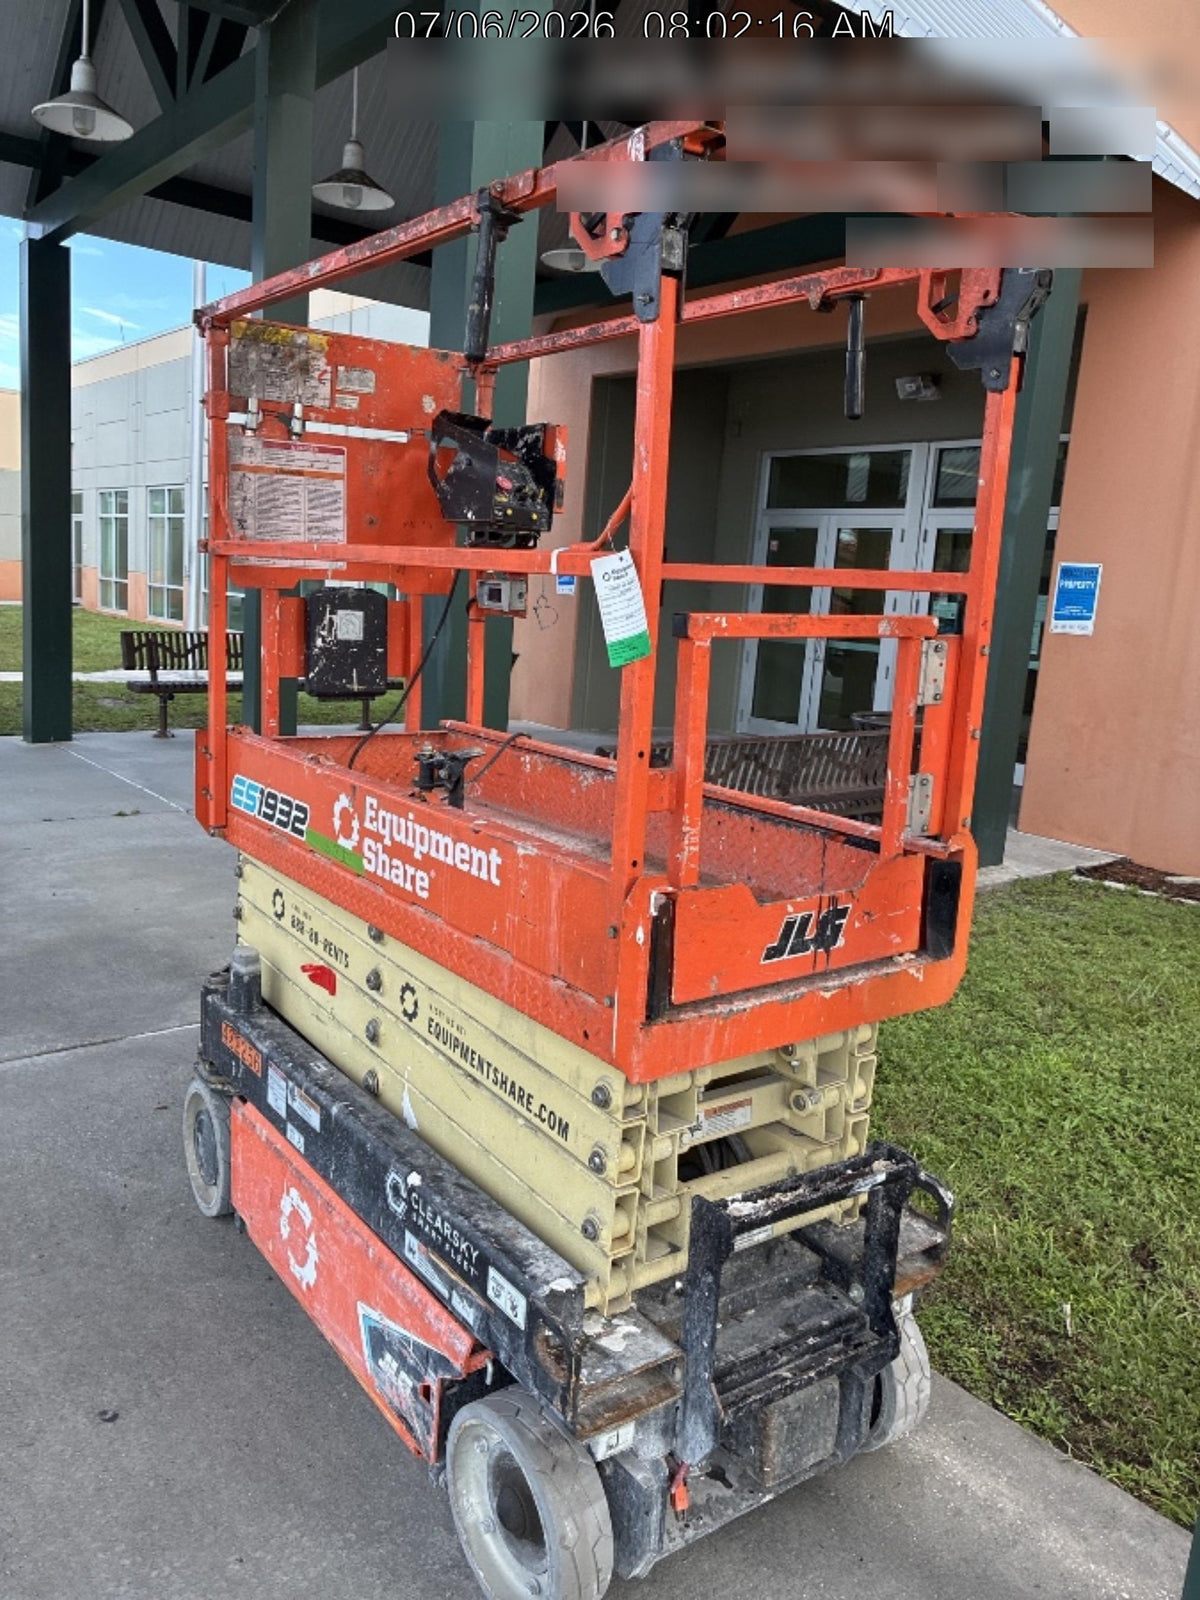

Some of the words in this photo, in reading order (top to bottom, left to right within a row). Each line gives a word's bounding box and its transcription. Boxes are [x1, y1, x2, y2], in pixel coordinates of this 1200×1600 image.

[231, 774, 309, 840] ES1932
[365, 795, 502, 886] Equipment
[362, 839, 430, 899] Share
[760, 903, 852, 965] JLG
[427, 1017, 570, 1142] EQUIPMENTSHARE.COM
[411, 1192, 480, 1266] CLEARSKY
